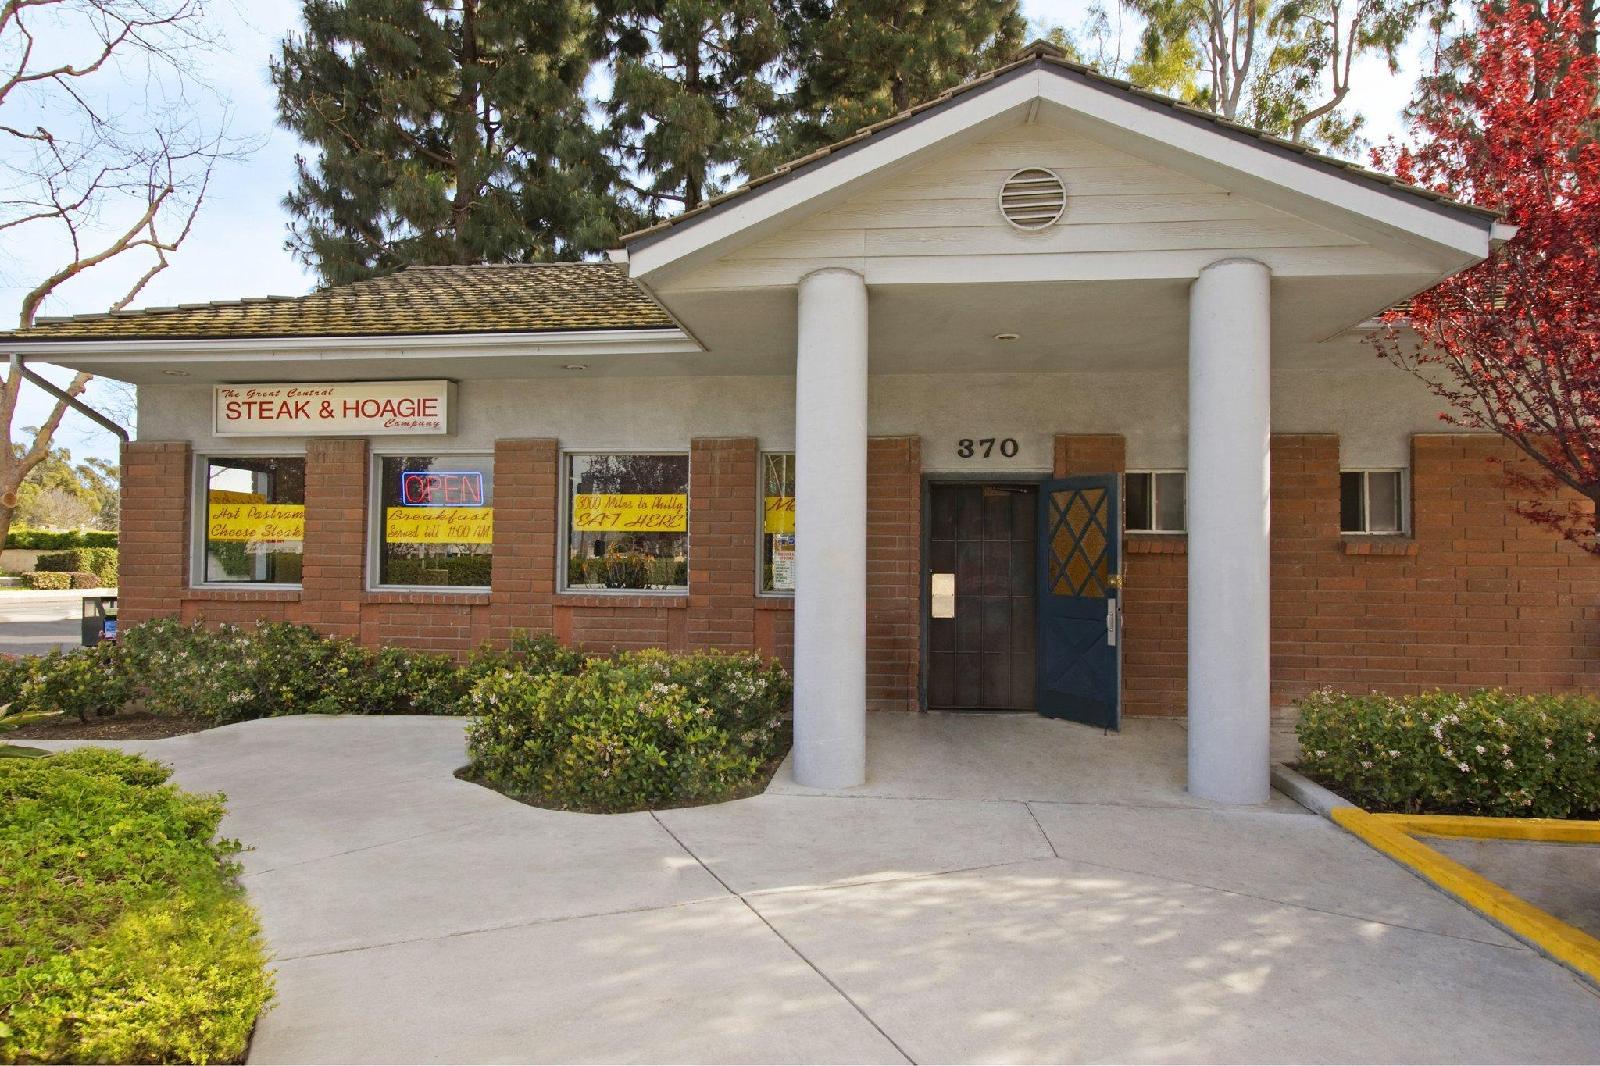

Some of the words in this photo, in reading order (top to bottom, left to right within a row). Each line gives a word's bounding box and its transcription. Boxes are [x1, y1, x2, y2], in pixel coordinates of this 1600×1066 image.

[221, 389, 241, 399] The
[246, 389, 281, 399] Great
[286, 387, 335, 398] Central
[225, 400, 311, 420] STEAK
[318, 399, 335, 419] &
[342, 398, 439, 418] HOAGIE
[383, 417, 442, 429] Company
[957, 437, 1019, 459] 370
[405, 475, 481, 503] OPEN
[212, 506, 241, 520] Hot
[247, 505, 306, 520] Pastram
[604, 495, 634, 510] Miles
[651, 495, 685, 514] Philly
[388, 509, 490, 525] Breakfast
[576, 512, 622, 528] EAT
[623, 513, 685, 529] HERE
[211, 522, 257, 538] Cheese
[387, 524, 420, 538] Served
